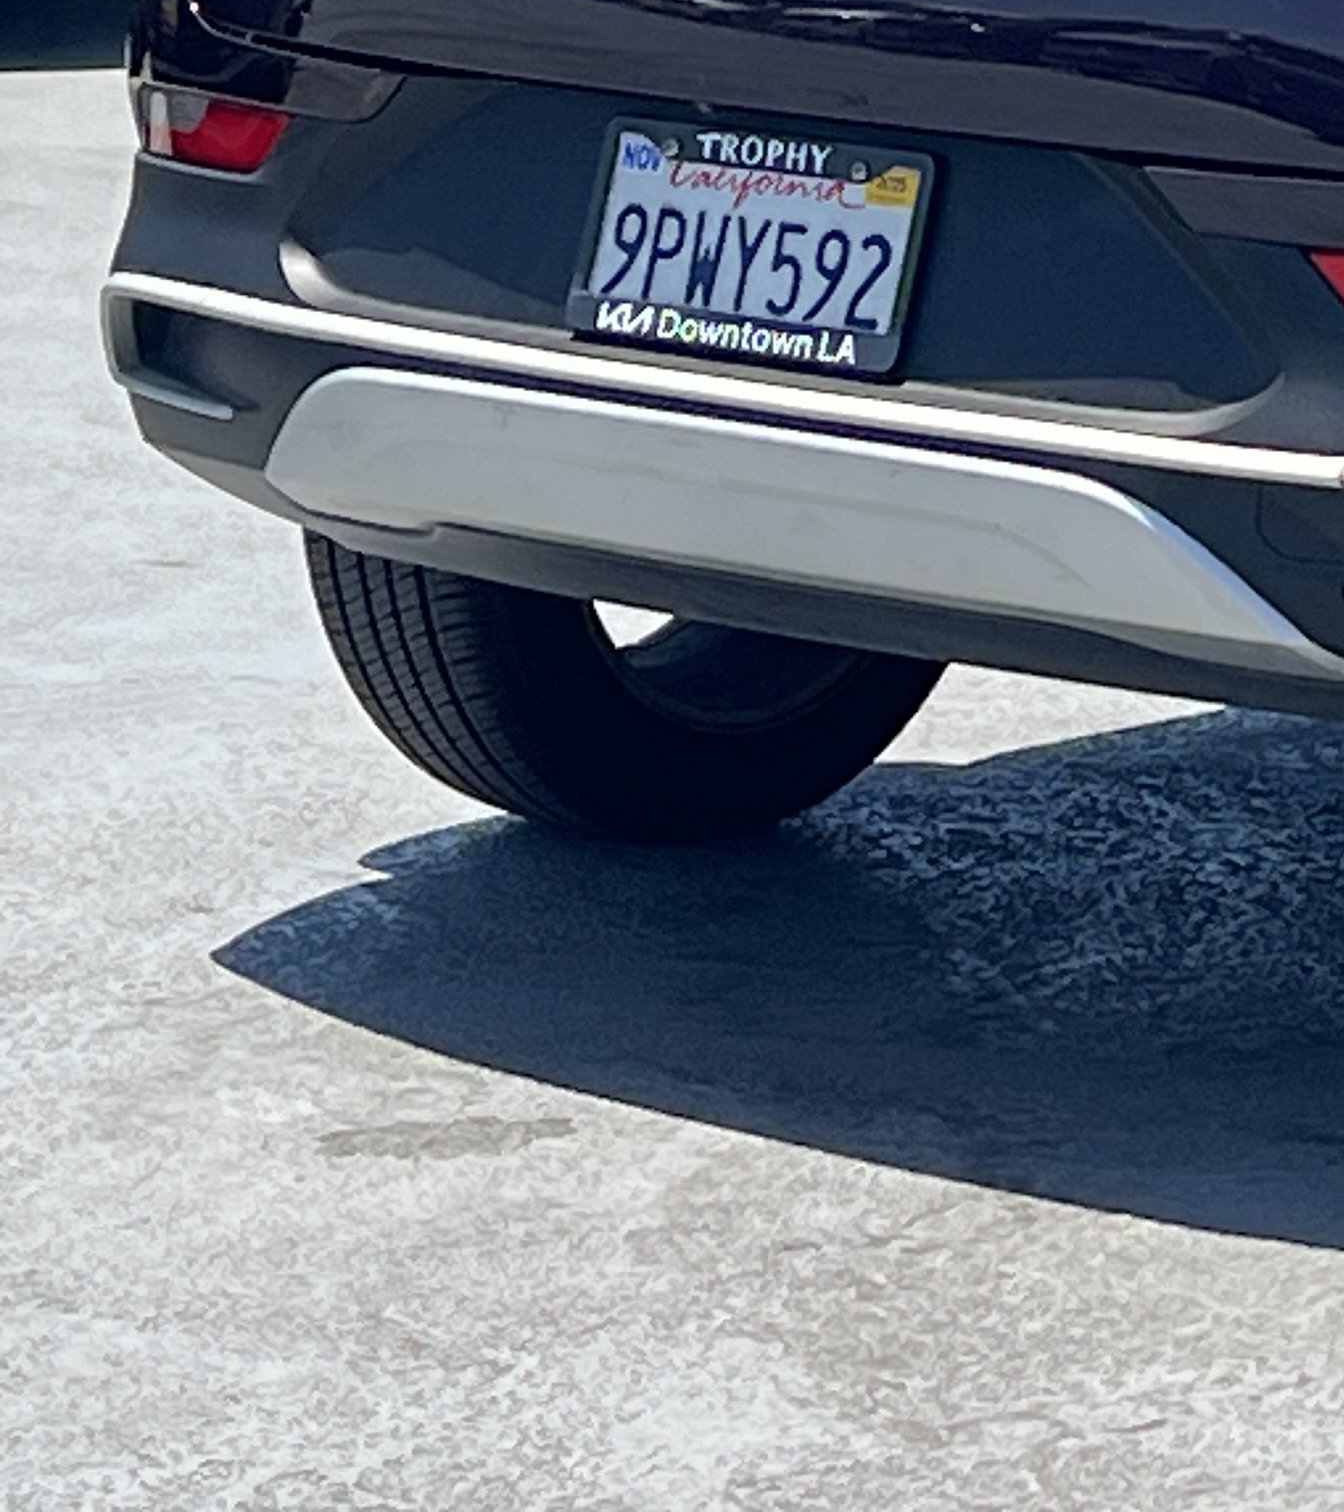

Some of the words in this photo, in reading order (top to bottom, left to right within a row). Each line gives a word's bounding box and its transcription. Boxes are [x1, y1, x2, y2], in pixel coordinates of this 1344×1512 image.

[696, 133, 833, 174] TROPHY
[669, 160, 865, 209] California
[601, 203, 893, 331] 9PWY592
[657, 308, 813, 360] Downtown
[817, 331, 856, 365] LA
